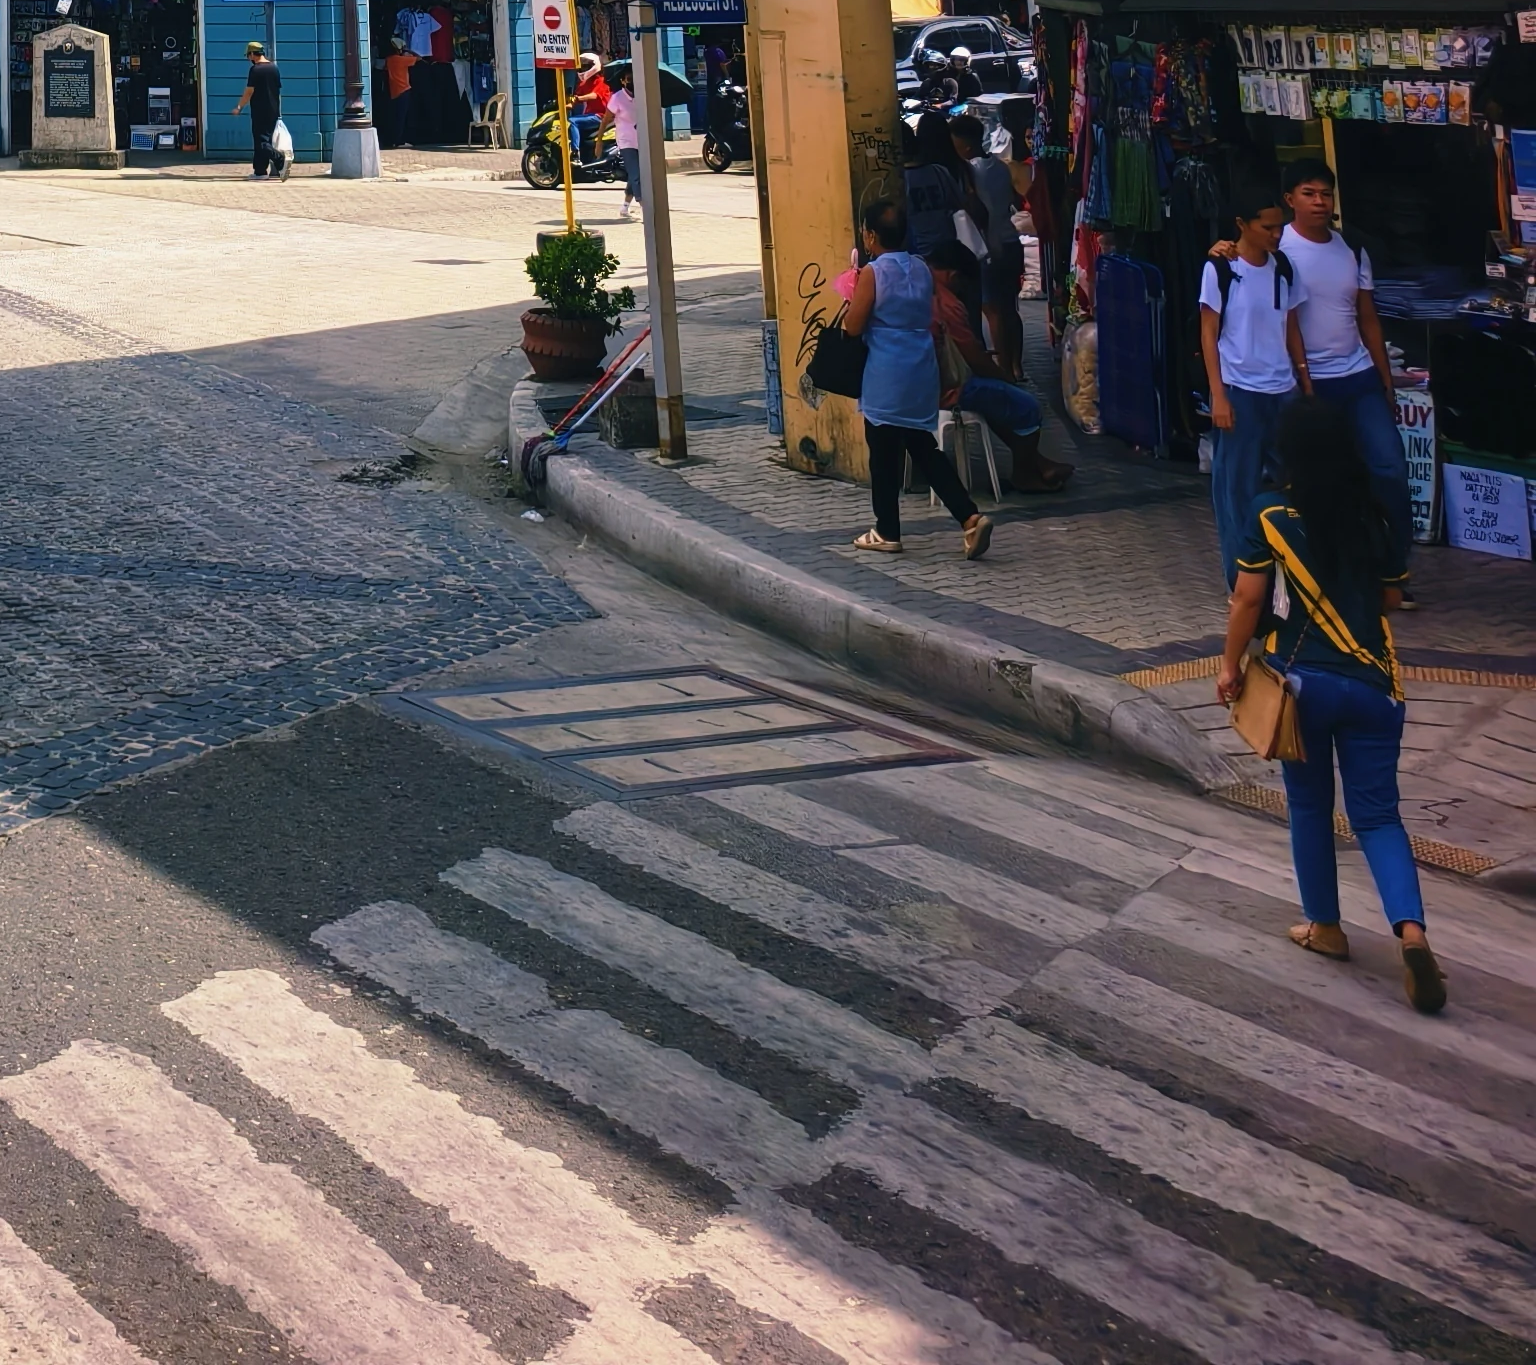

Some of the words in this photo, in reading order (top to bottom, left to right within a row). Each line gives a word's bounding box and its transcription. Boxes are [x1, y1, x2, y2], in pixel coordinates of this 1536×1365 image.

[537, 34, 547, 44] NO
[548, 34, 570, 45] ENTRY
[544, 46, 555, 54] ONE
[555, 46, 567, 54] WAY
[1395, 404, 1433, 429] BUY
[1408, 435, 1433, 460] INK
